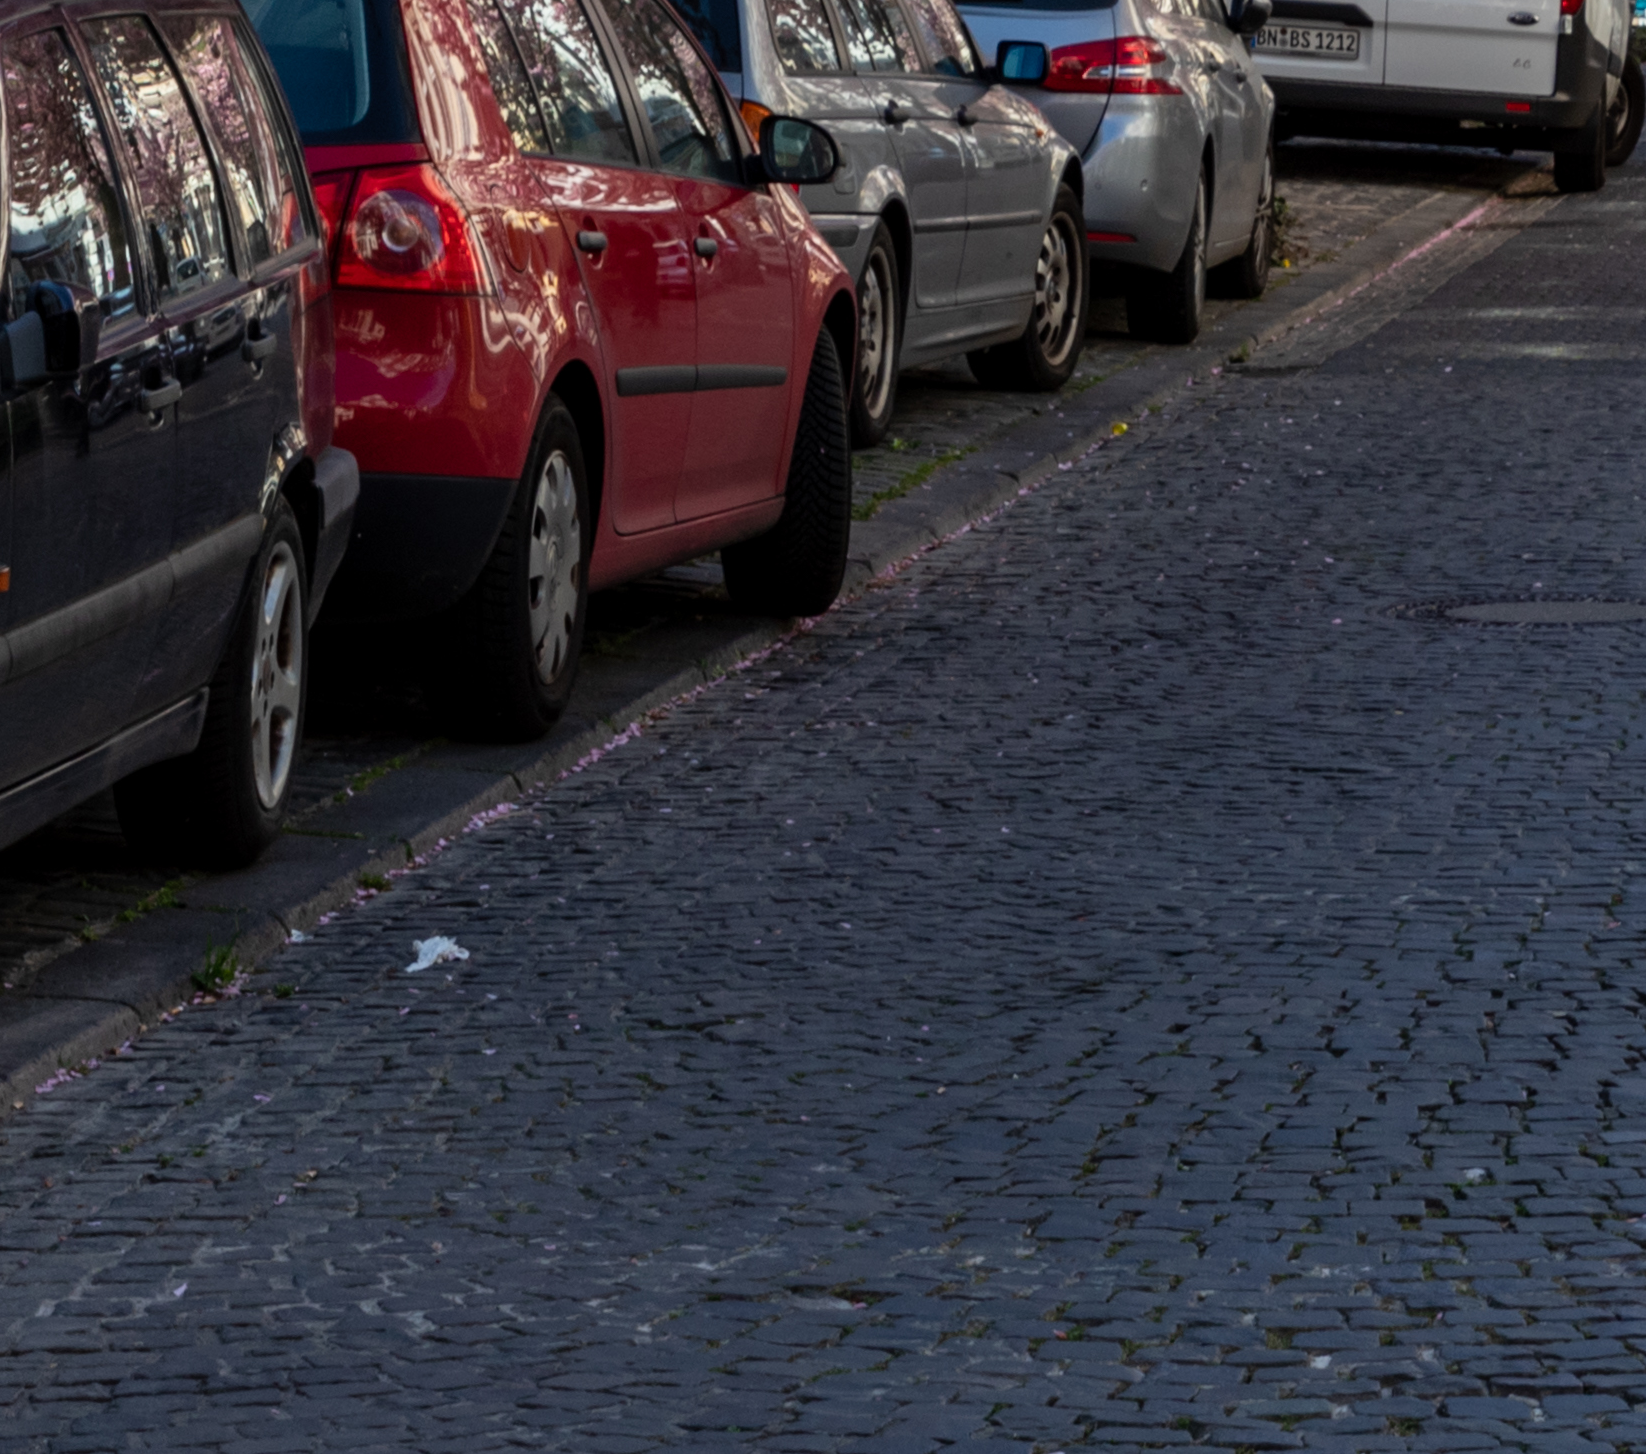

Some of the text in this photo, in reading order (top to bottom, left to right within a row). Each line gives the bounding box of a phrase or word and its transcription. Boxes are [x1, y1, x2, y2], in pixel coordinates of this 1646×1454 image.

[1256, 30, 1356, 53] BN BS 1212
